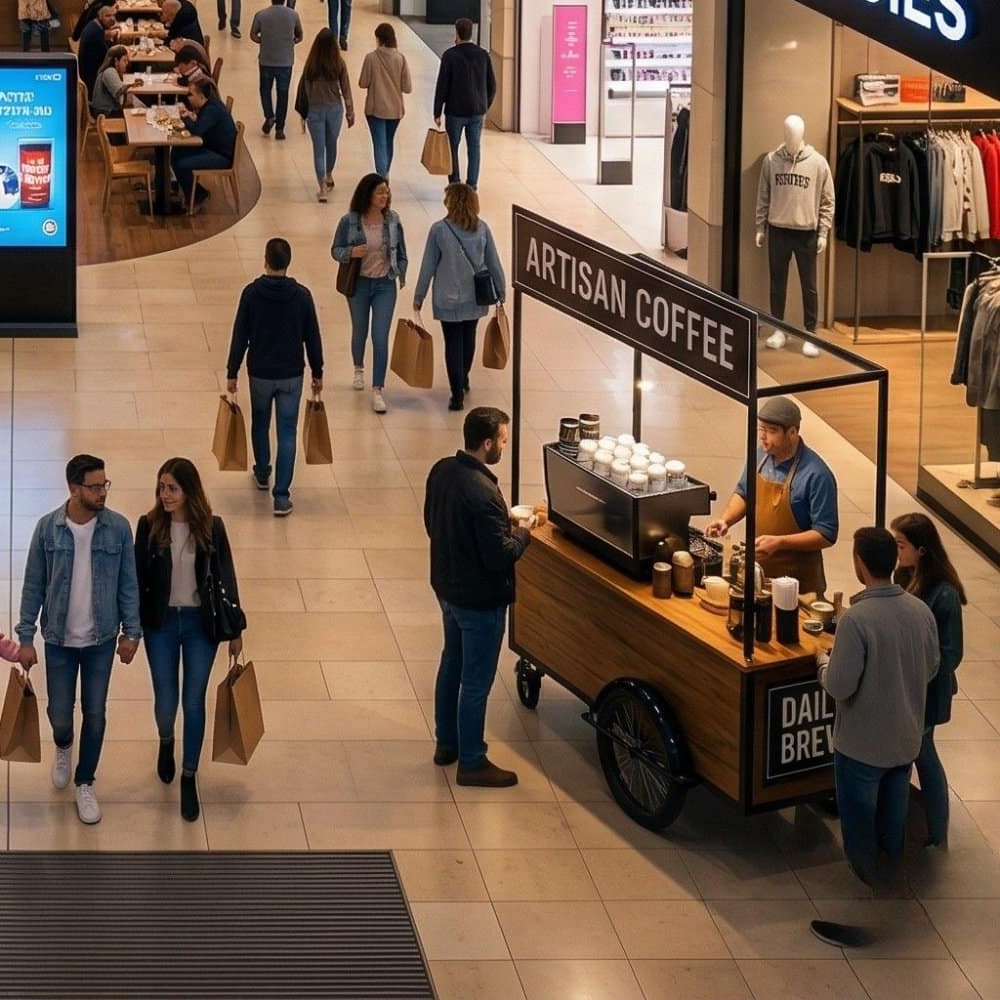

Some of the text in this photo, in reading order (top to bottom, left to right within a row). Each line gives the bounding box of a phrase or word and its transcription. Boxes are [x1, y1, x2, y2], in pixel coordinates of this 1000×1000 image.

[526, 236, 735, 371] ARTISAN COFFEE
[782, 688, 834, 729] DAIL
